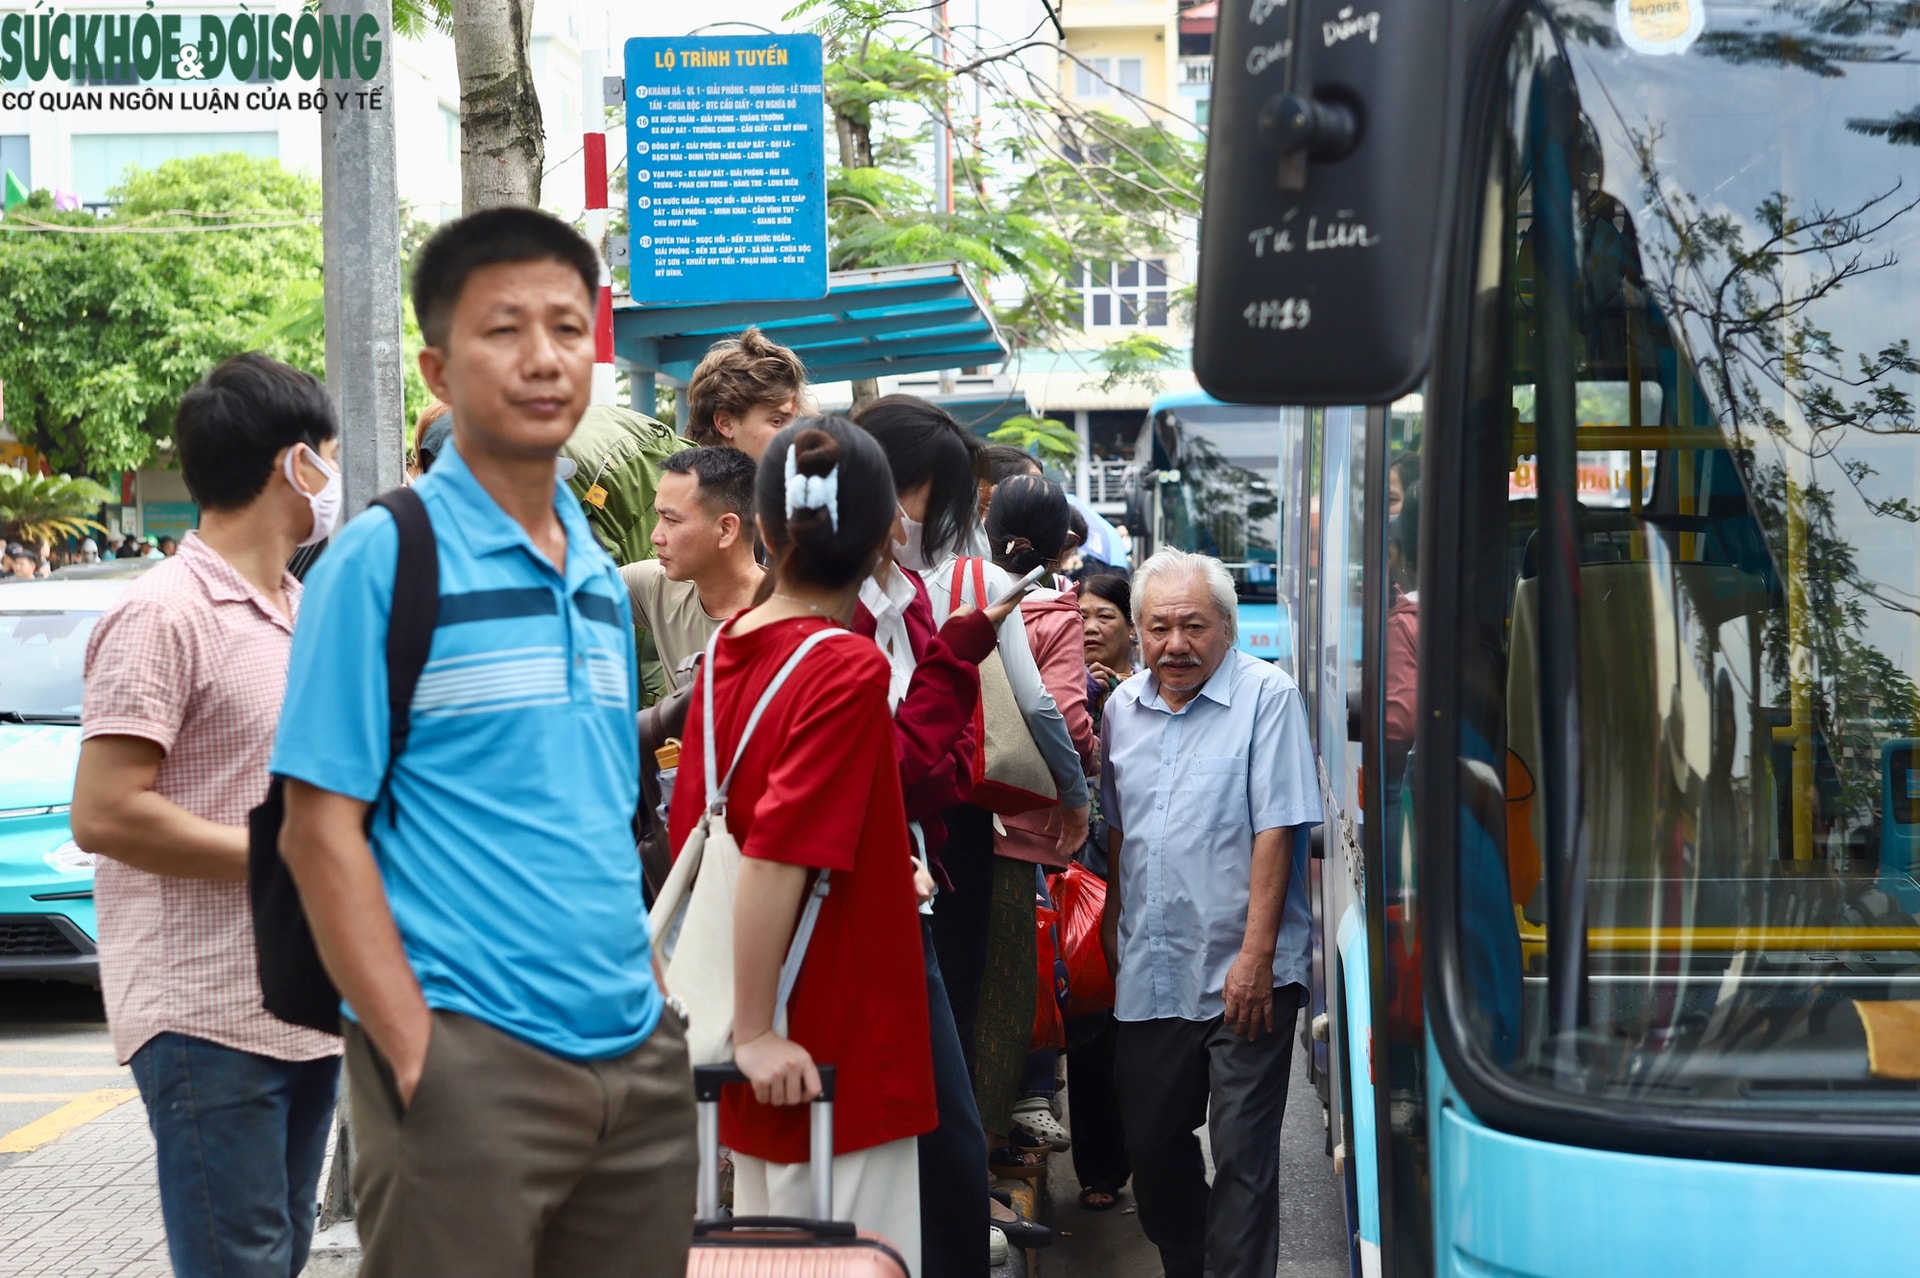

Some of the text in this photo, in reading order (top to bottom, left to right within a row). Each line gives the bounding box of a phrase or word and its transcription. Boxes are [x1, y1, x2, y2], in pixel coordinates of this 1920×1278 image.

[655, 43, 788, 72] LỘ TRÌNH TUYẾN
